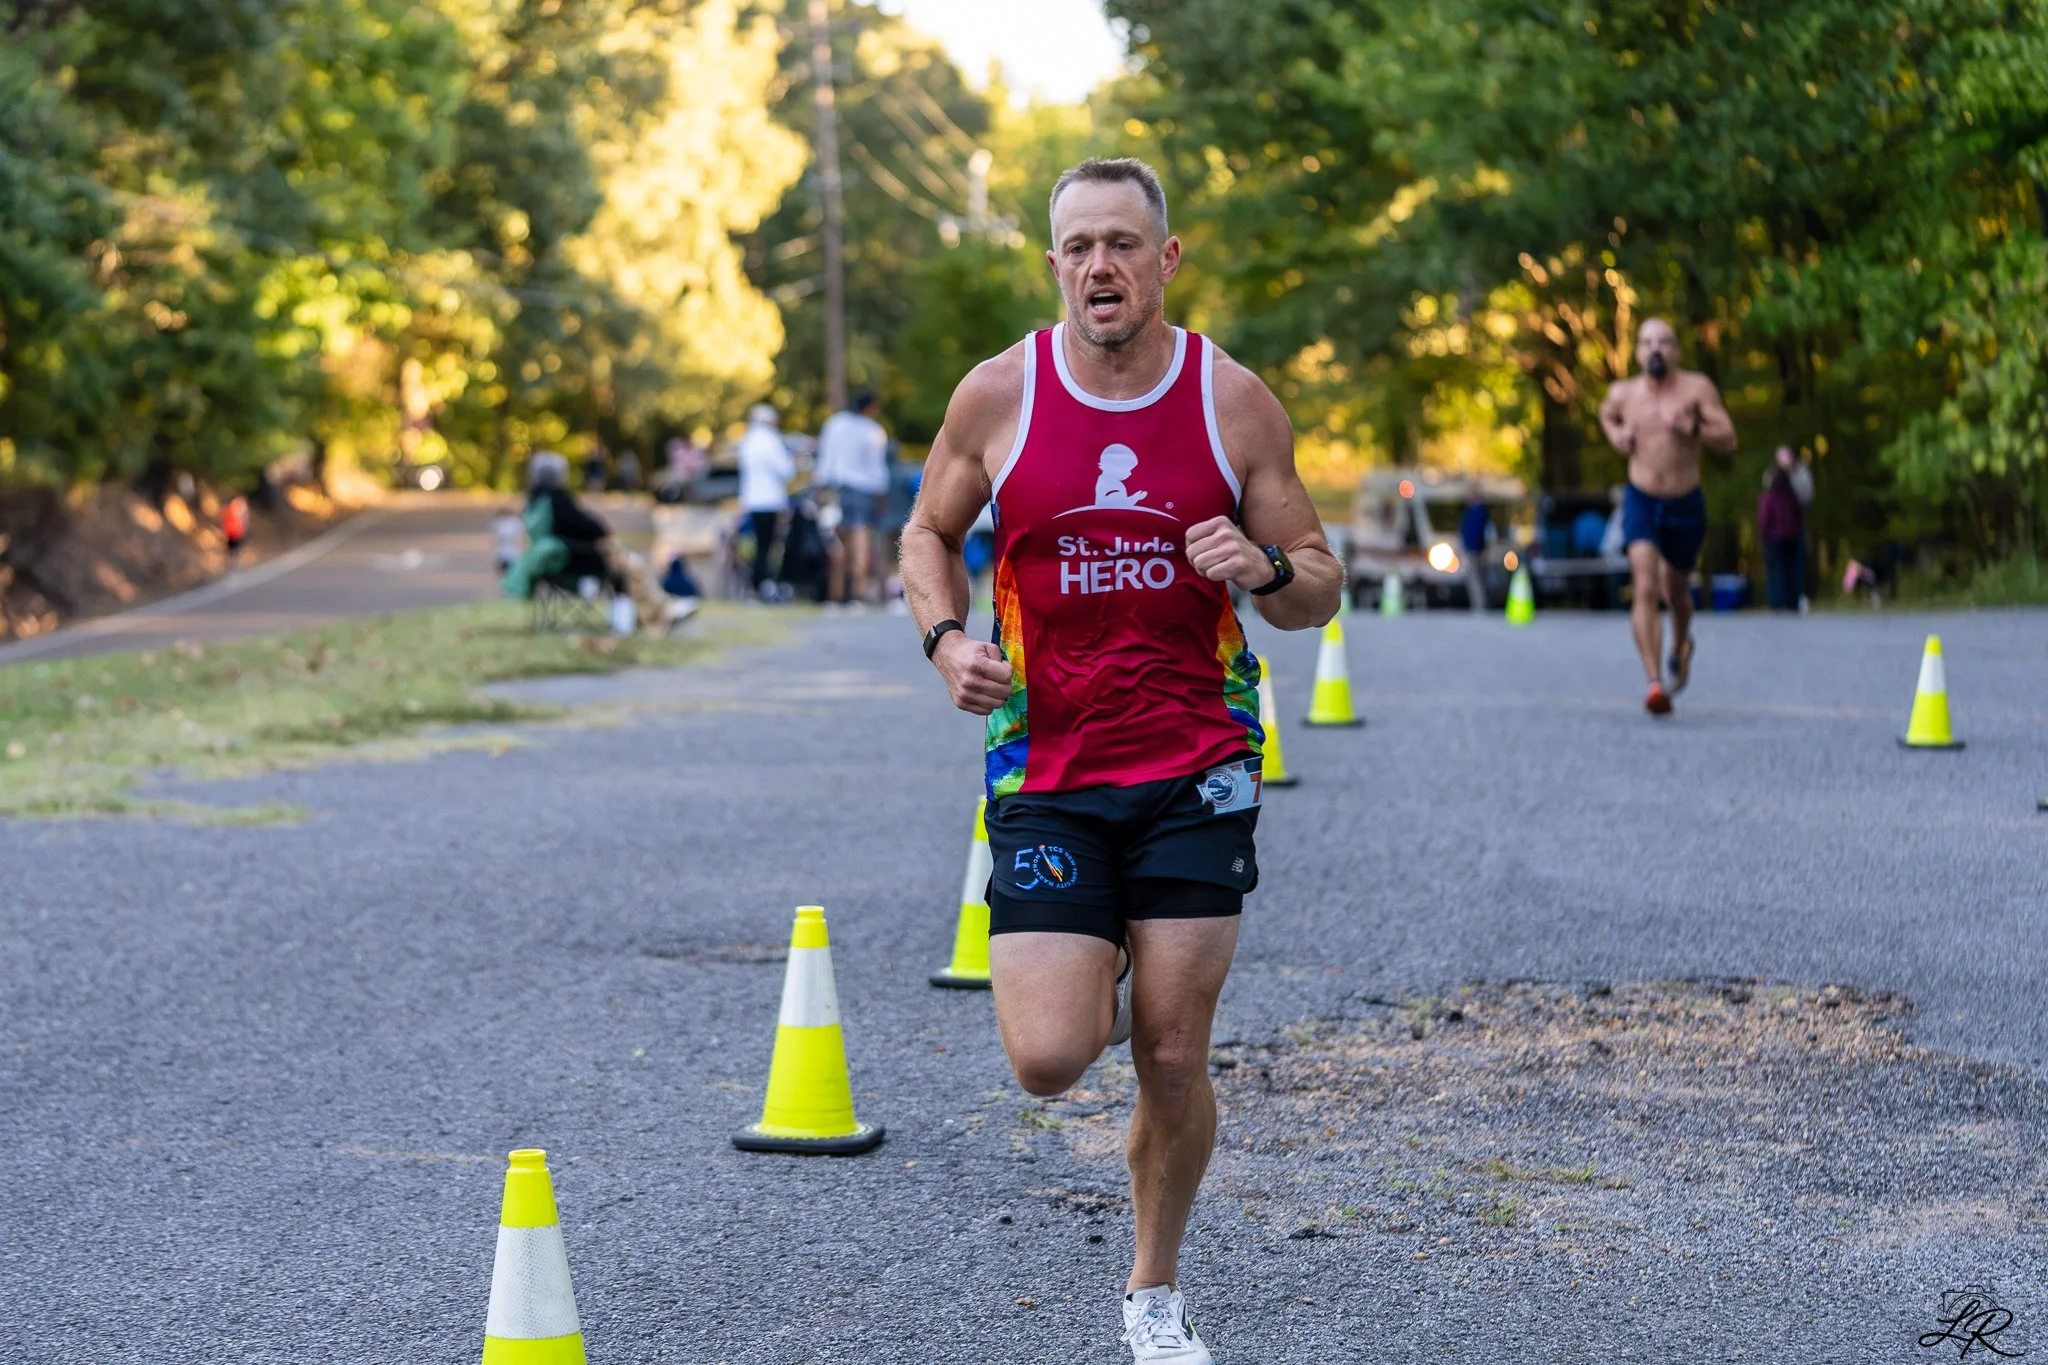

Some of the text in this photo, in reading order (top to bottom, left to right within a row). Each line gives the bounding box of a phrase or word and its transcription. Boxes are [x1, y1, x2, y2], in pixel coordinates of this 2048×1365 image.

[1057, 535, 1176, 557] St. Jude
[1060, 557, 1176, 595] HERO
[1064, 852, 1076, 866] NEW
[1032, 854, 1055, 887] MARATHON
[1056, 881, 1072, 889] CITY
